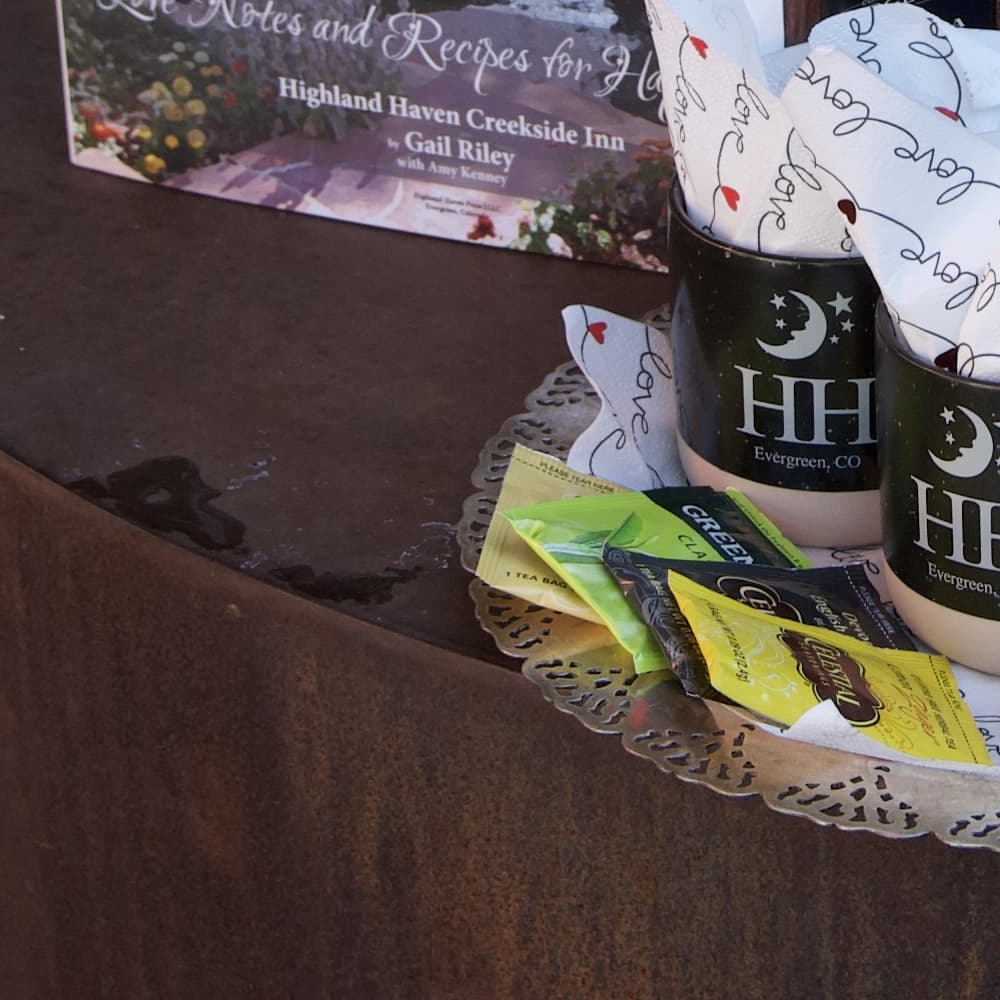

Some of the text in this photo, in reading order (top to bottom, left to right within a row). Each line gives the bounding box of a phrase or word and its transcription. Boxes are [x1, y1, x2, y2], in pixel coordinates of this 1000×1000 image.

[312, 4, 377, 48] and
[381, 9, 532, 97] Recipes
[541, 36, 592, 82] for
[278, 76, 626, 153] Highland Haven Creekside Inn
[731, 80, 771, 155] love
[794, 56, 870, 137] love
[396, 157, 509, 188] with Amy Kenney
[404, 131, 453, 158] Gail
[457, 138, 516, 174] Riley
[893, 147, 975, 206] love
[768, 161, 823, 231] love
[900, 248, 980, 311] love
[631, 350, 673, 435] love
[754, 445, 862, 471] Evergreen, CO
[516, 572, 538, 582] TEA
[542, 577, 569, 590] BAG
[927, 561, 998, 599] Evergreen,
[804, 636, 861, 707] CELESTIAL
